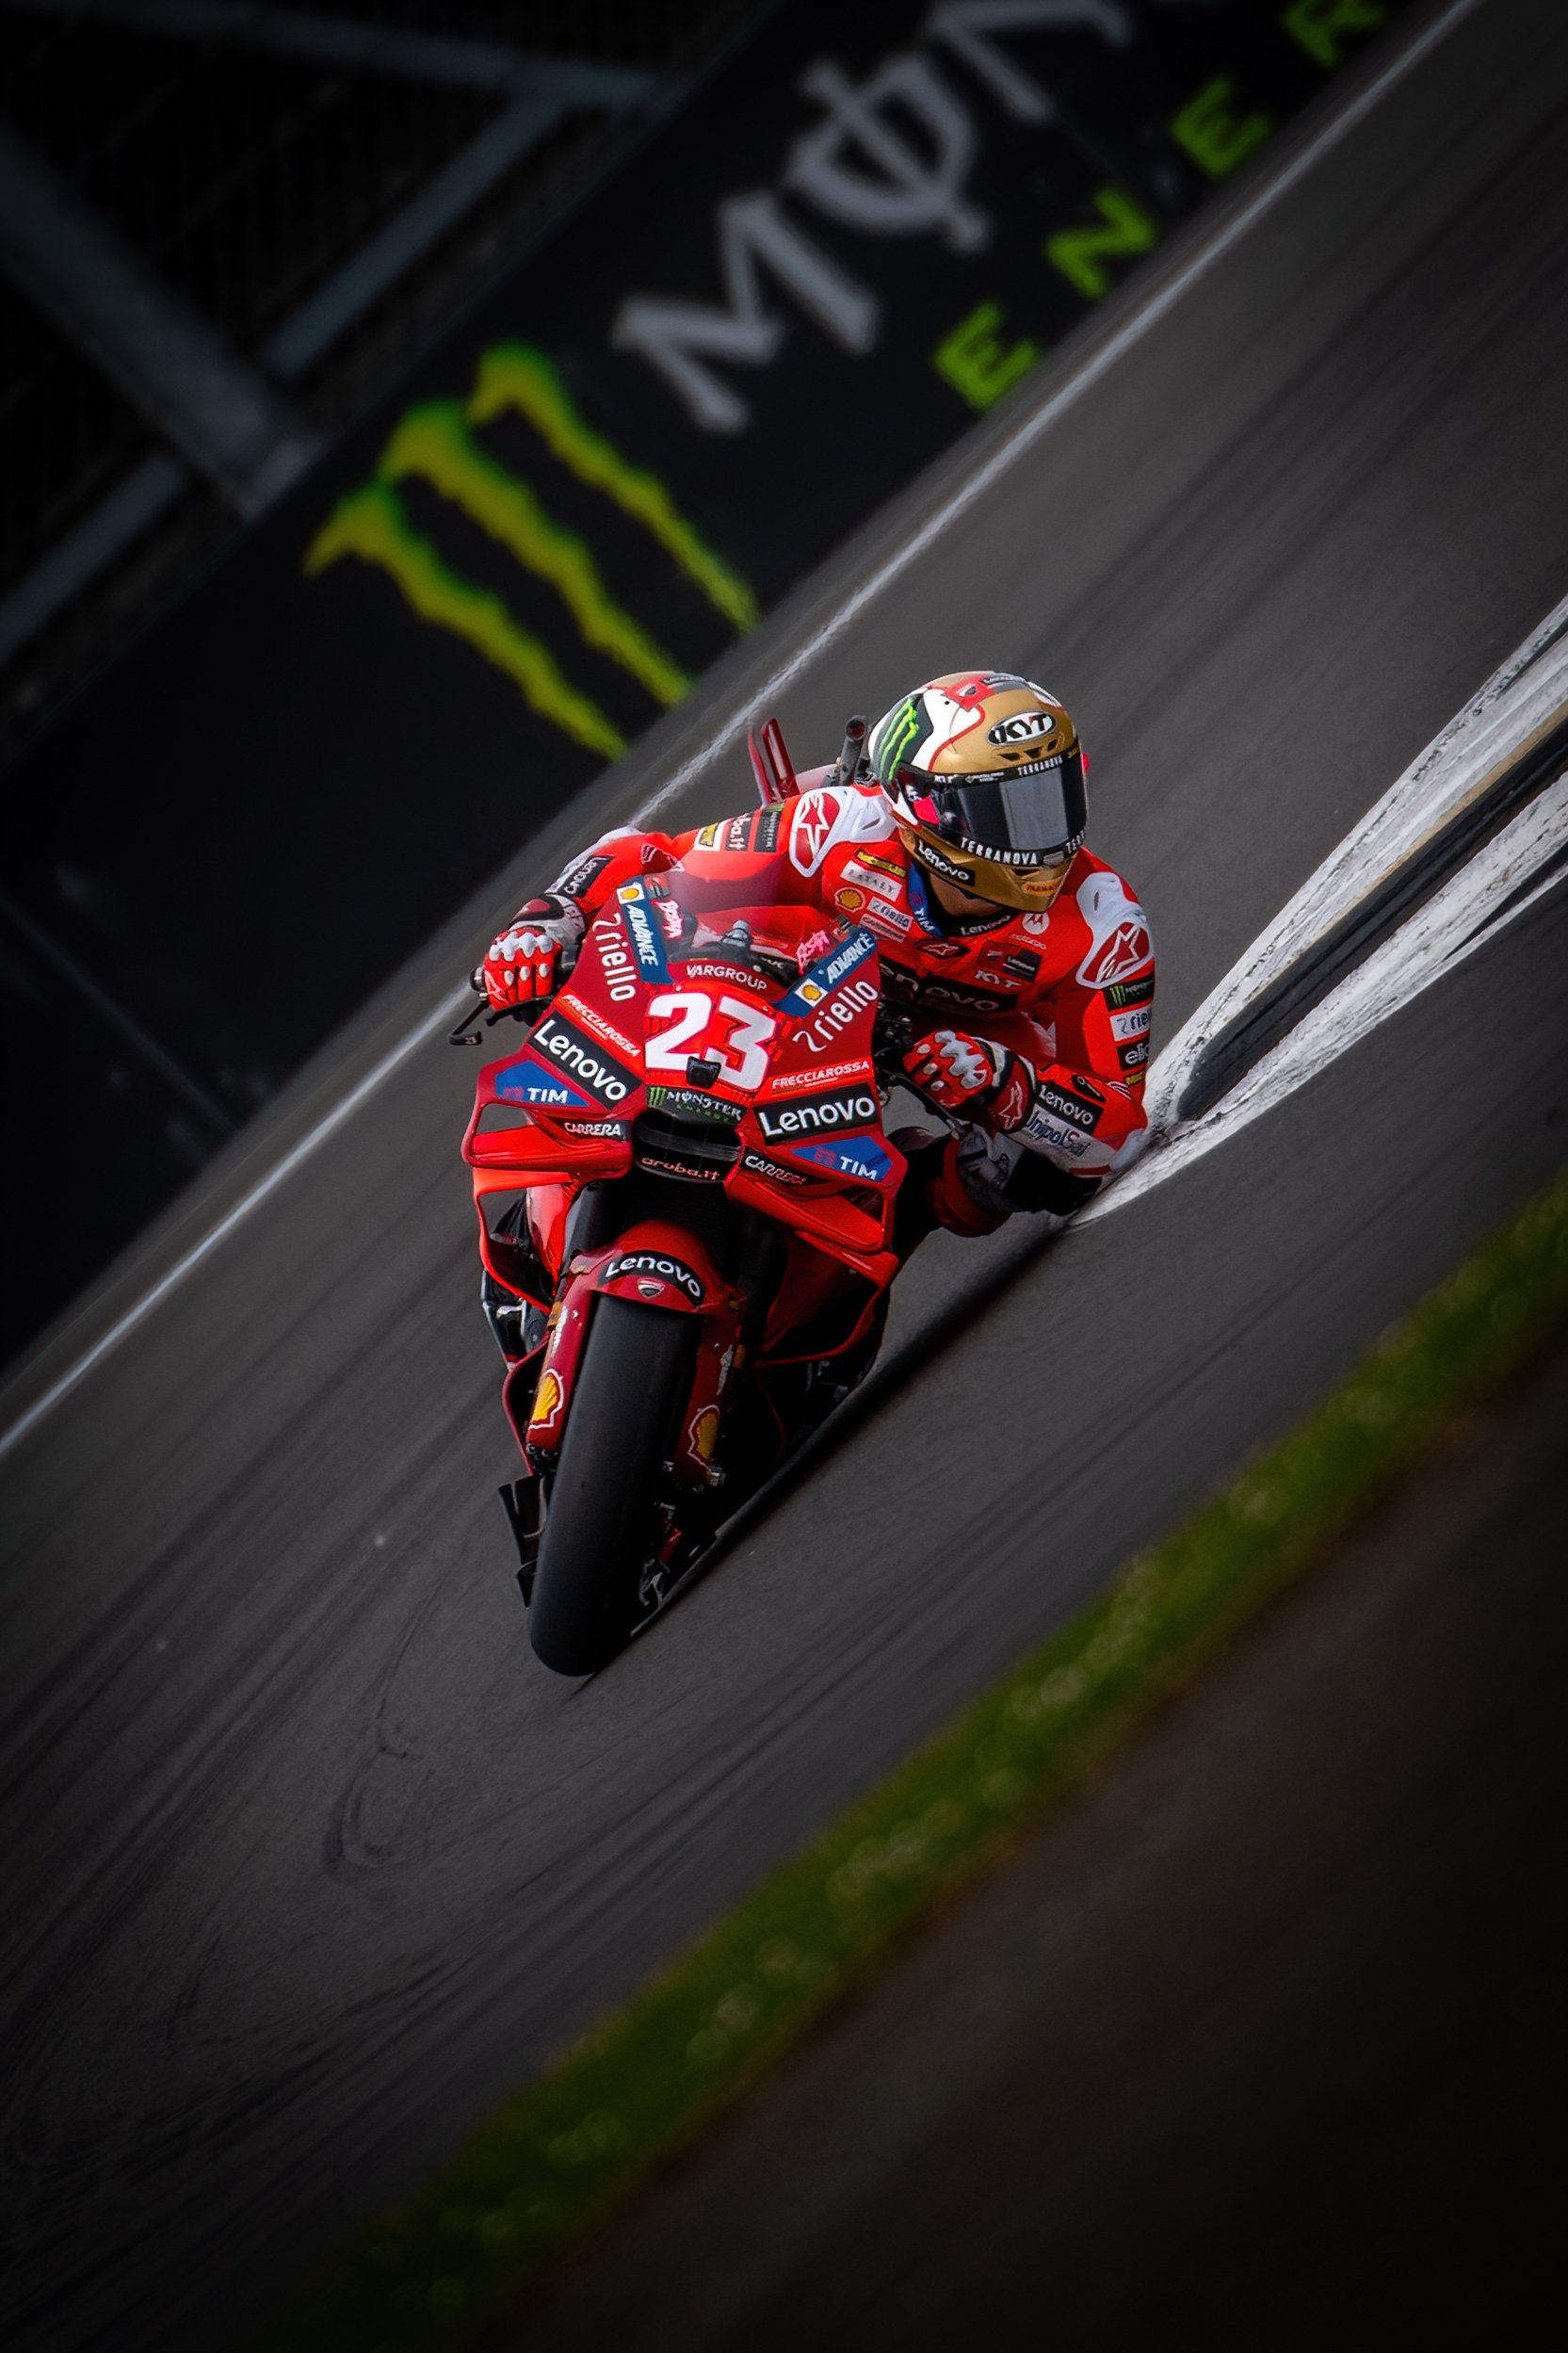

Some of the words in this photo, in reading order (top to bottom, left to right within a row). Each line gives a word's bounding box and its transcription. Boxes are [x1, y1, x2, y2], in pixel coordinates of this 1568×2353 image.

[988, 712, 1053, 744] KYT
[917, 839, 970, 881] Lenovo
[961, 836, 1038, 866] TERRANOVA
[913, 907, 935, 932] TIM
[960, 915, 1011, 936] Lenovo
[624, 904, 659, 967] ADVANCE
[827, 933, 877, 984] ADVANCE
[686, 964, 768, 991] VARGROUP
[562, 994, 641, 1057] FRECCIAROSSA
[644, 992, 778, 1092] 23
[533, 1019, 627, 1101] Lenovo
[770, 1060, 871, 1089] FRECCIAROSSA
[526, 1087, 569, 1104] TIM
[666, 1090, 743, 1121] MONSTER
[1038, 1084, 1094, 1126] Lenovo
[564, 1122, 622, 1137] CARRERA
[758, 1095, 877, 1138] Lenovo
[641, 1157, 720, 1180] aruba.it
[744, 1155, 807, 1185] CARRERA
[839, 1155, 878, 1181] TIM
[605, 1257, 702, 1298] Lenovo
